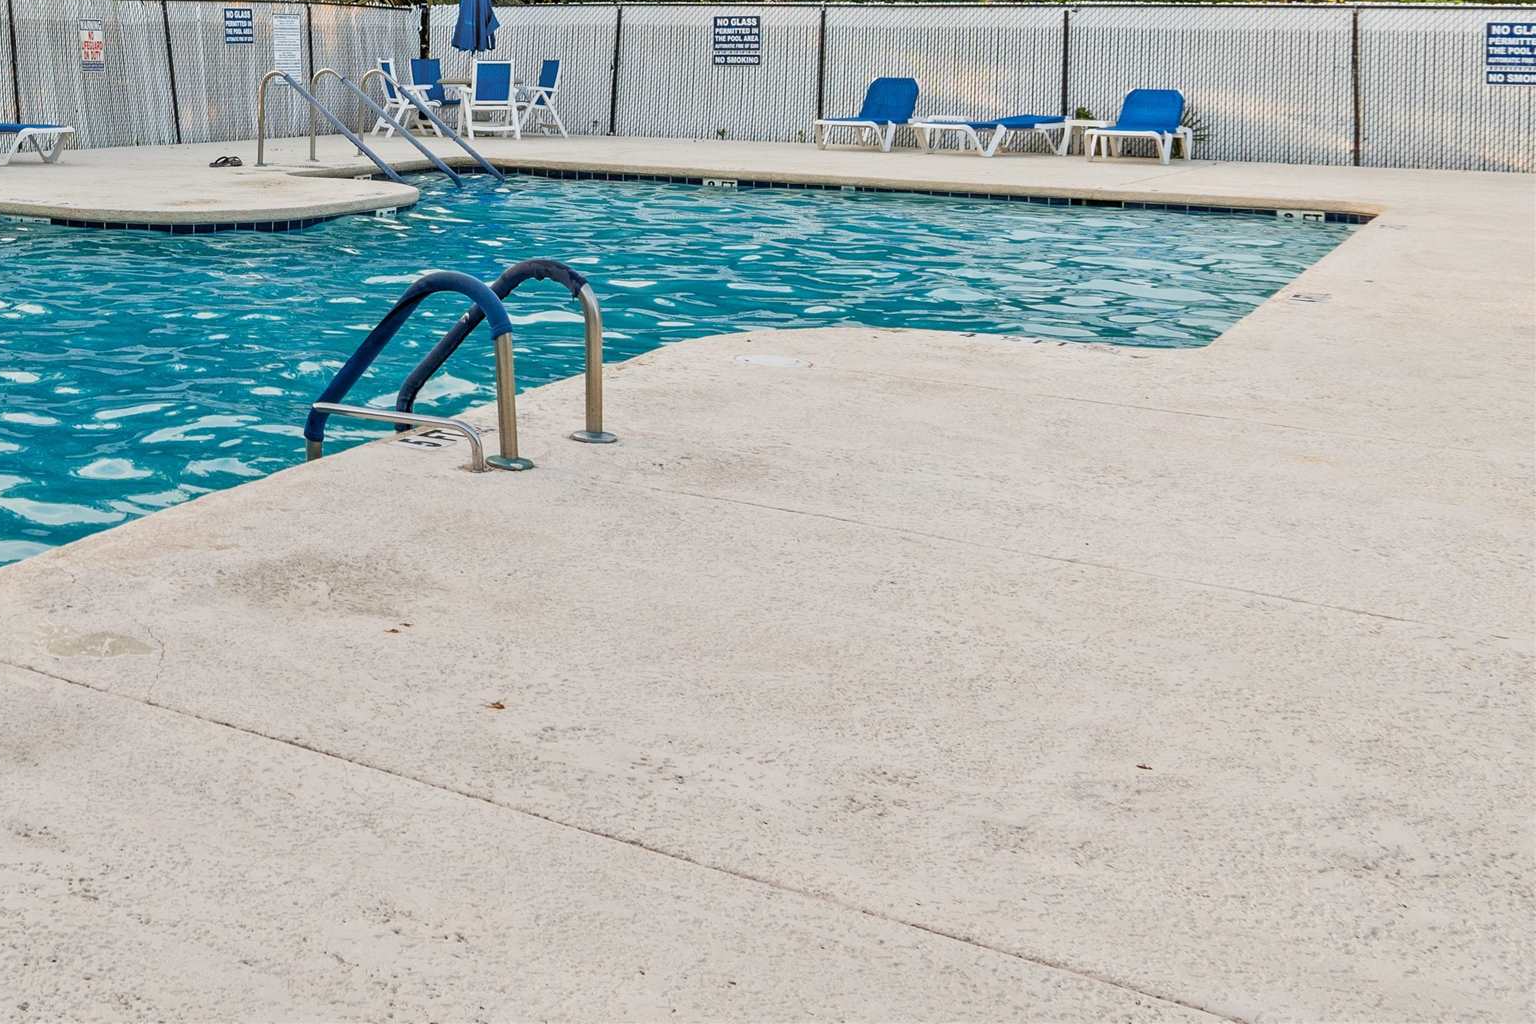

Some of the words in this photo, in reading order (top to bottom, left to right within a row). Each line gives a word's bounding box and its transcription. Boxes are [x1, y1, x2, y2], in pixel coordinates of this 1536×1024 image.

[716, 18, 729, 26] NO
[730, 18, 757, 26] GLASS
[1491, 25, 1511, 35] NO
[1507, 46, 1531, 55] POOL
[715, 56, 726, 64] NO
[726, 56, 759, 64] SMOKING
[1488, 73, 1505, 83] NO
